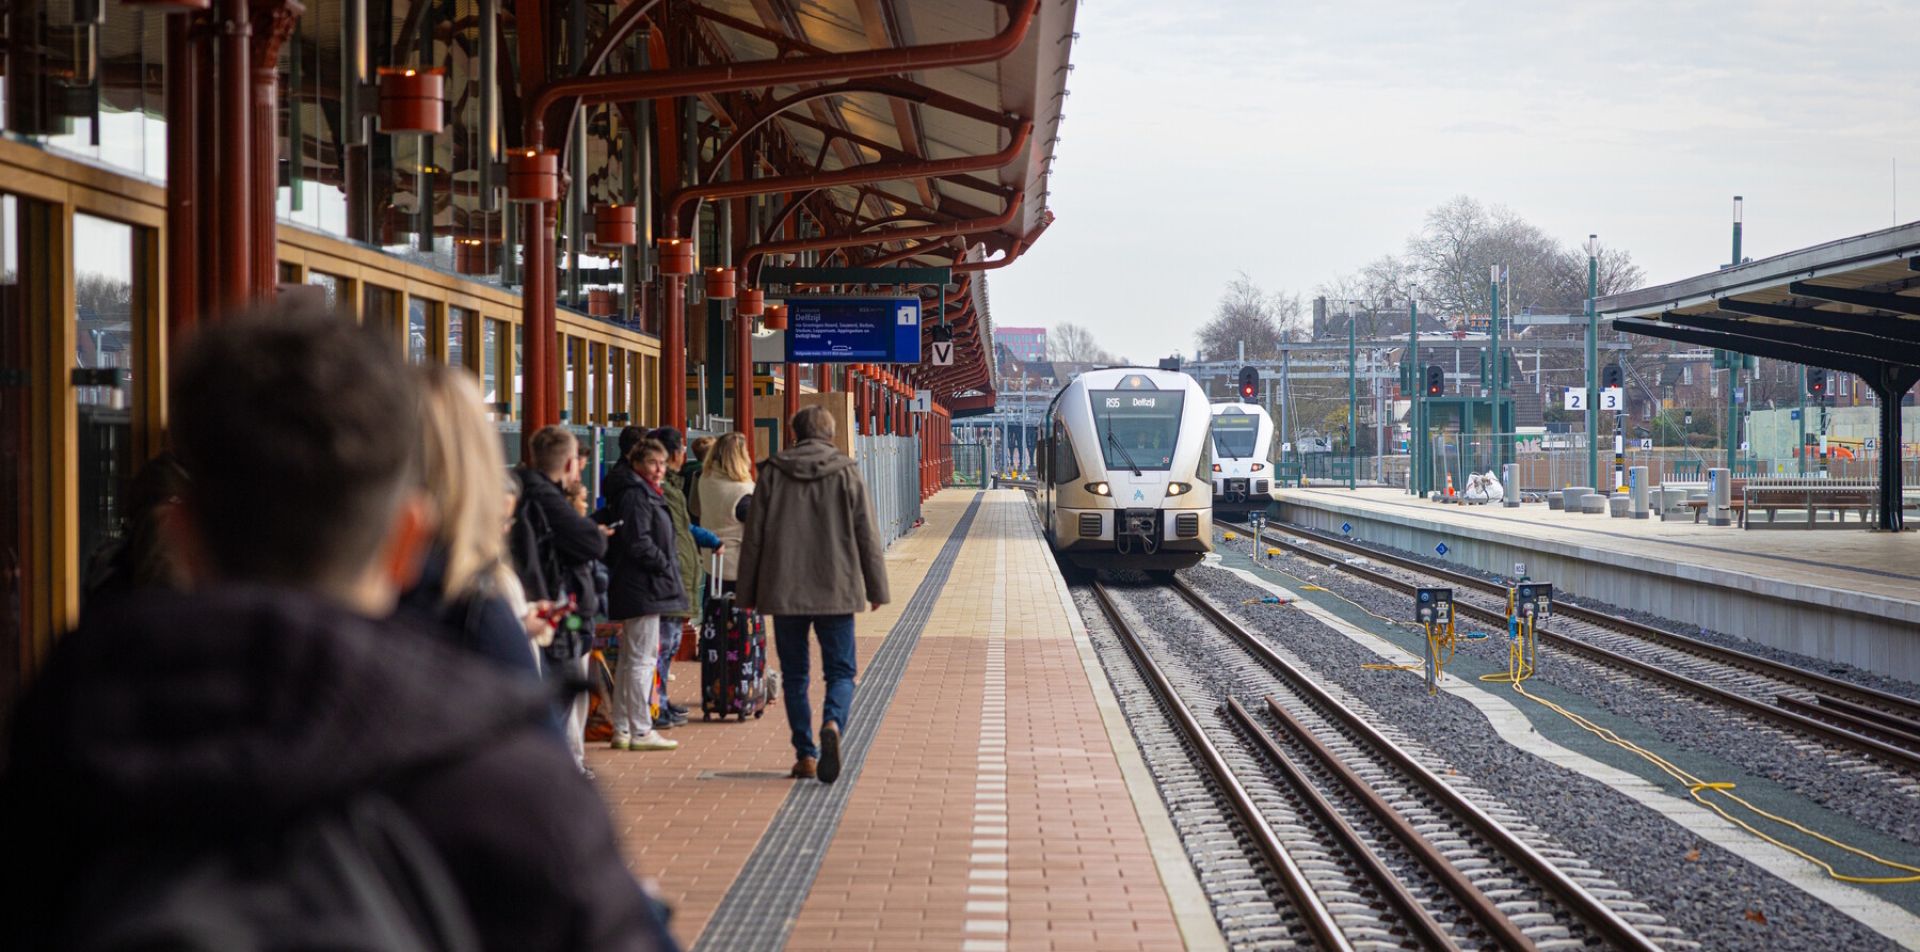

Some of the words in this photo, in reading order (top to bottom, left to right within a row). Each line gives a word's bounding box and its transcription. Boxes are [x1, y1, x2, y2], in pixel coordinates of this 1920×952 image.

[795, 313, 821, 322] Delfzijl
[904, 313, 909, 323] 1
[934, 344, 951, 363] V
[917, 398, 923, 410] 1
[1132, 397, 1155, 408] Delfzijl
[1571, 396, 1580, 408] 2
[1607, 396, 1616, 408] 3
[1643, 440, 1650, 449] 4
[1867, 440, 1874, 449] 4
